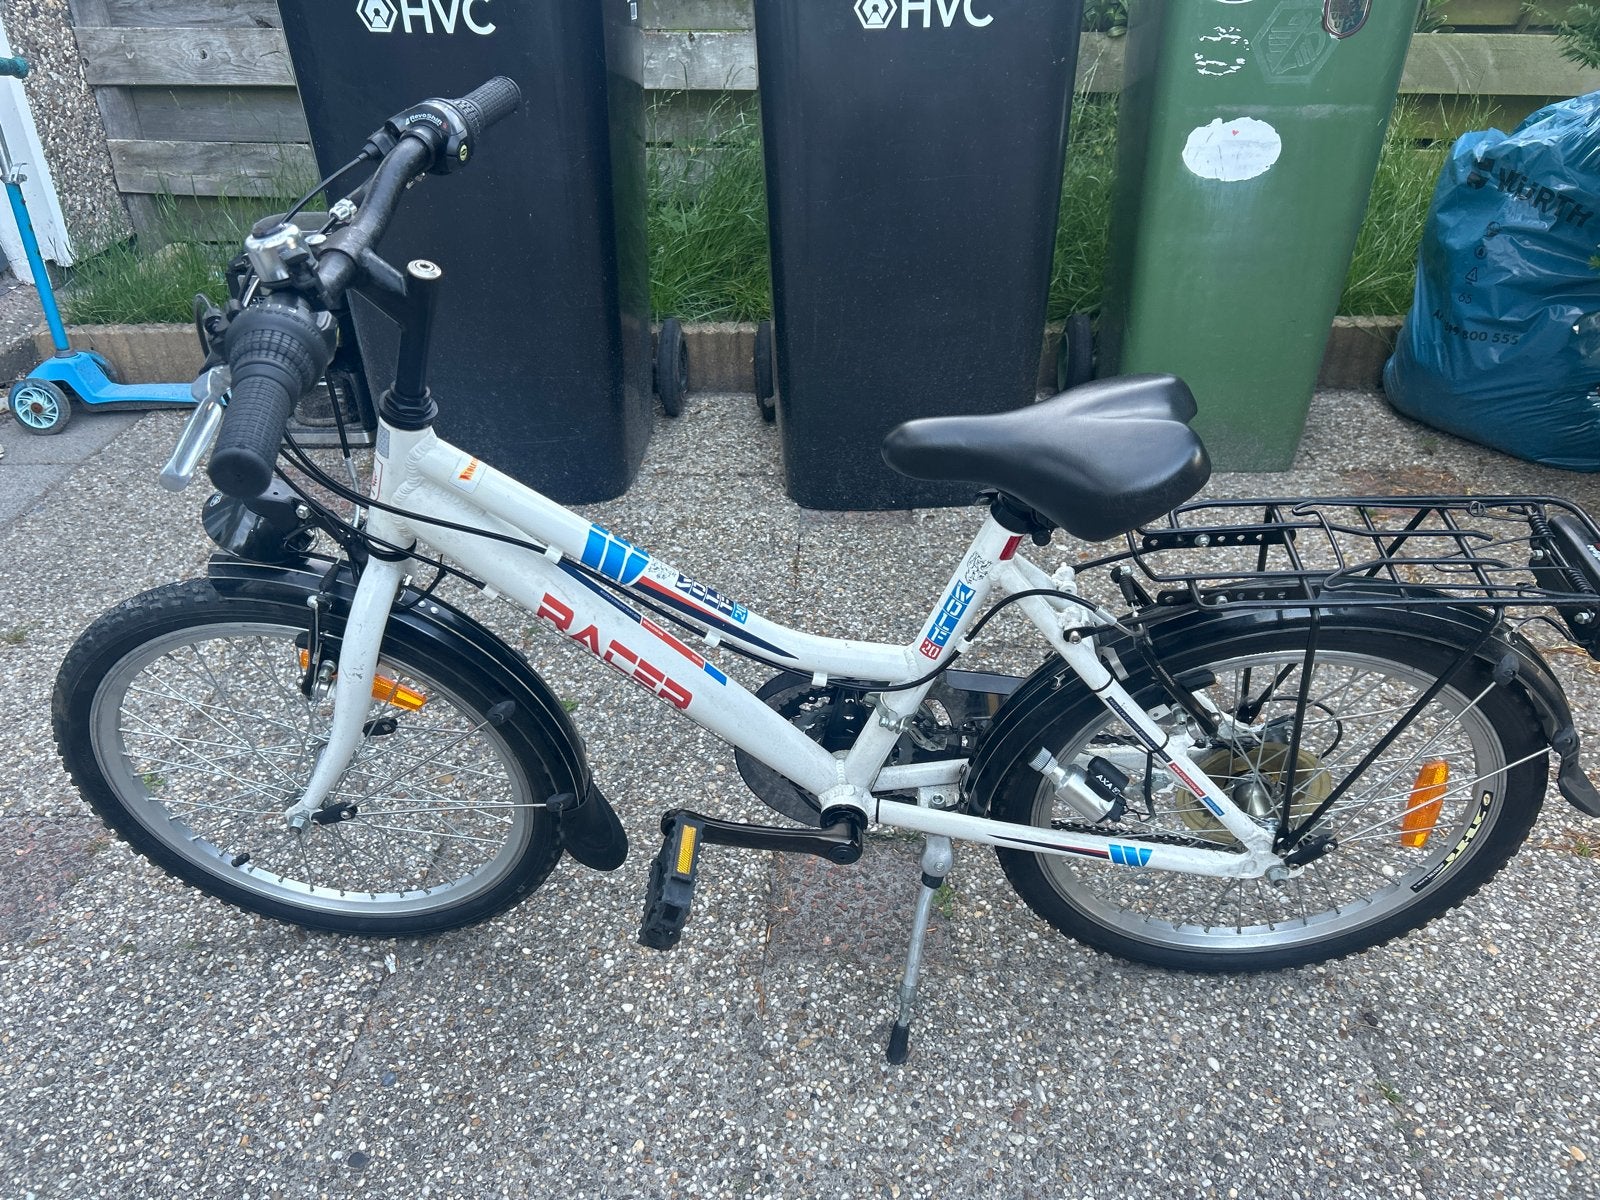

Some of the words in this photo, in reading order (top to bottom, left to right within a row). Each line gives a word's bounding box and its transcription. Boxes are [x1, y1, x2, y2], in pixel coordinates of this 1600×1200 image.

[400, 0, 497, 35] HVC
[901, 0, 994, 29] HVC
[1462, 330, 1488, 342] 800
[1491, 333, 1519, 346] 555
[537, 592, 693, 710] RACER
[921, 641, 942, 660] 20
[1095, 774, 1113, 790] AXA
